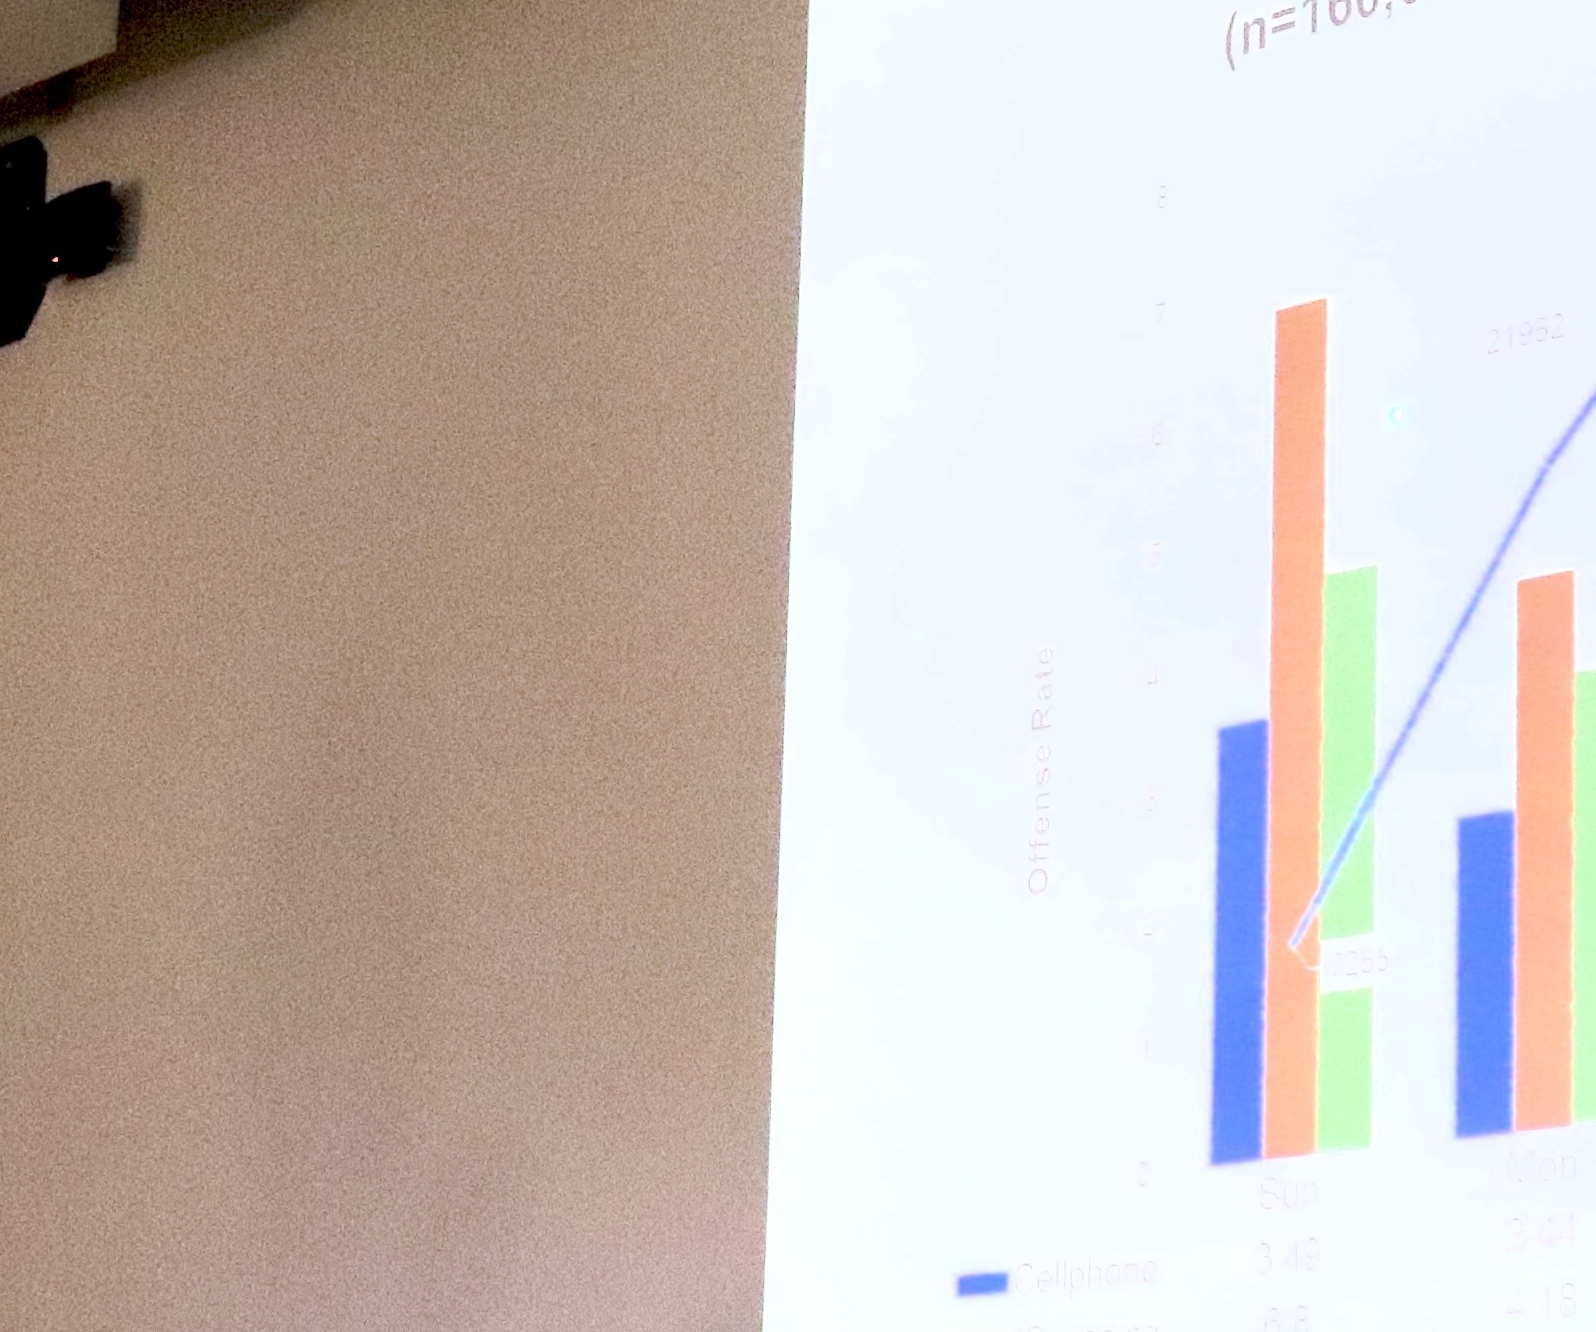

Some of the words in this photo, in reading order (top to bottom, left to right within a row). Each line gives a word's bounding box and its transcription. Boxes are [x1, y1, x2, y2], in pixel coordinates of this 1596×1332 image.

[1258, 1174, 1320, 1211] Sun
[1256, 1235, 1321, 1275] 349
[1506, 1280, 1577, 1318] 418
